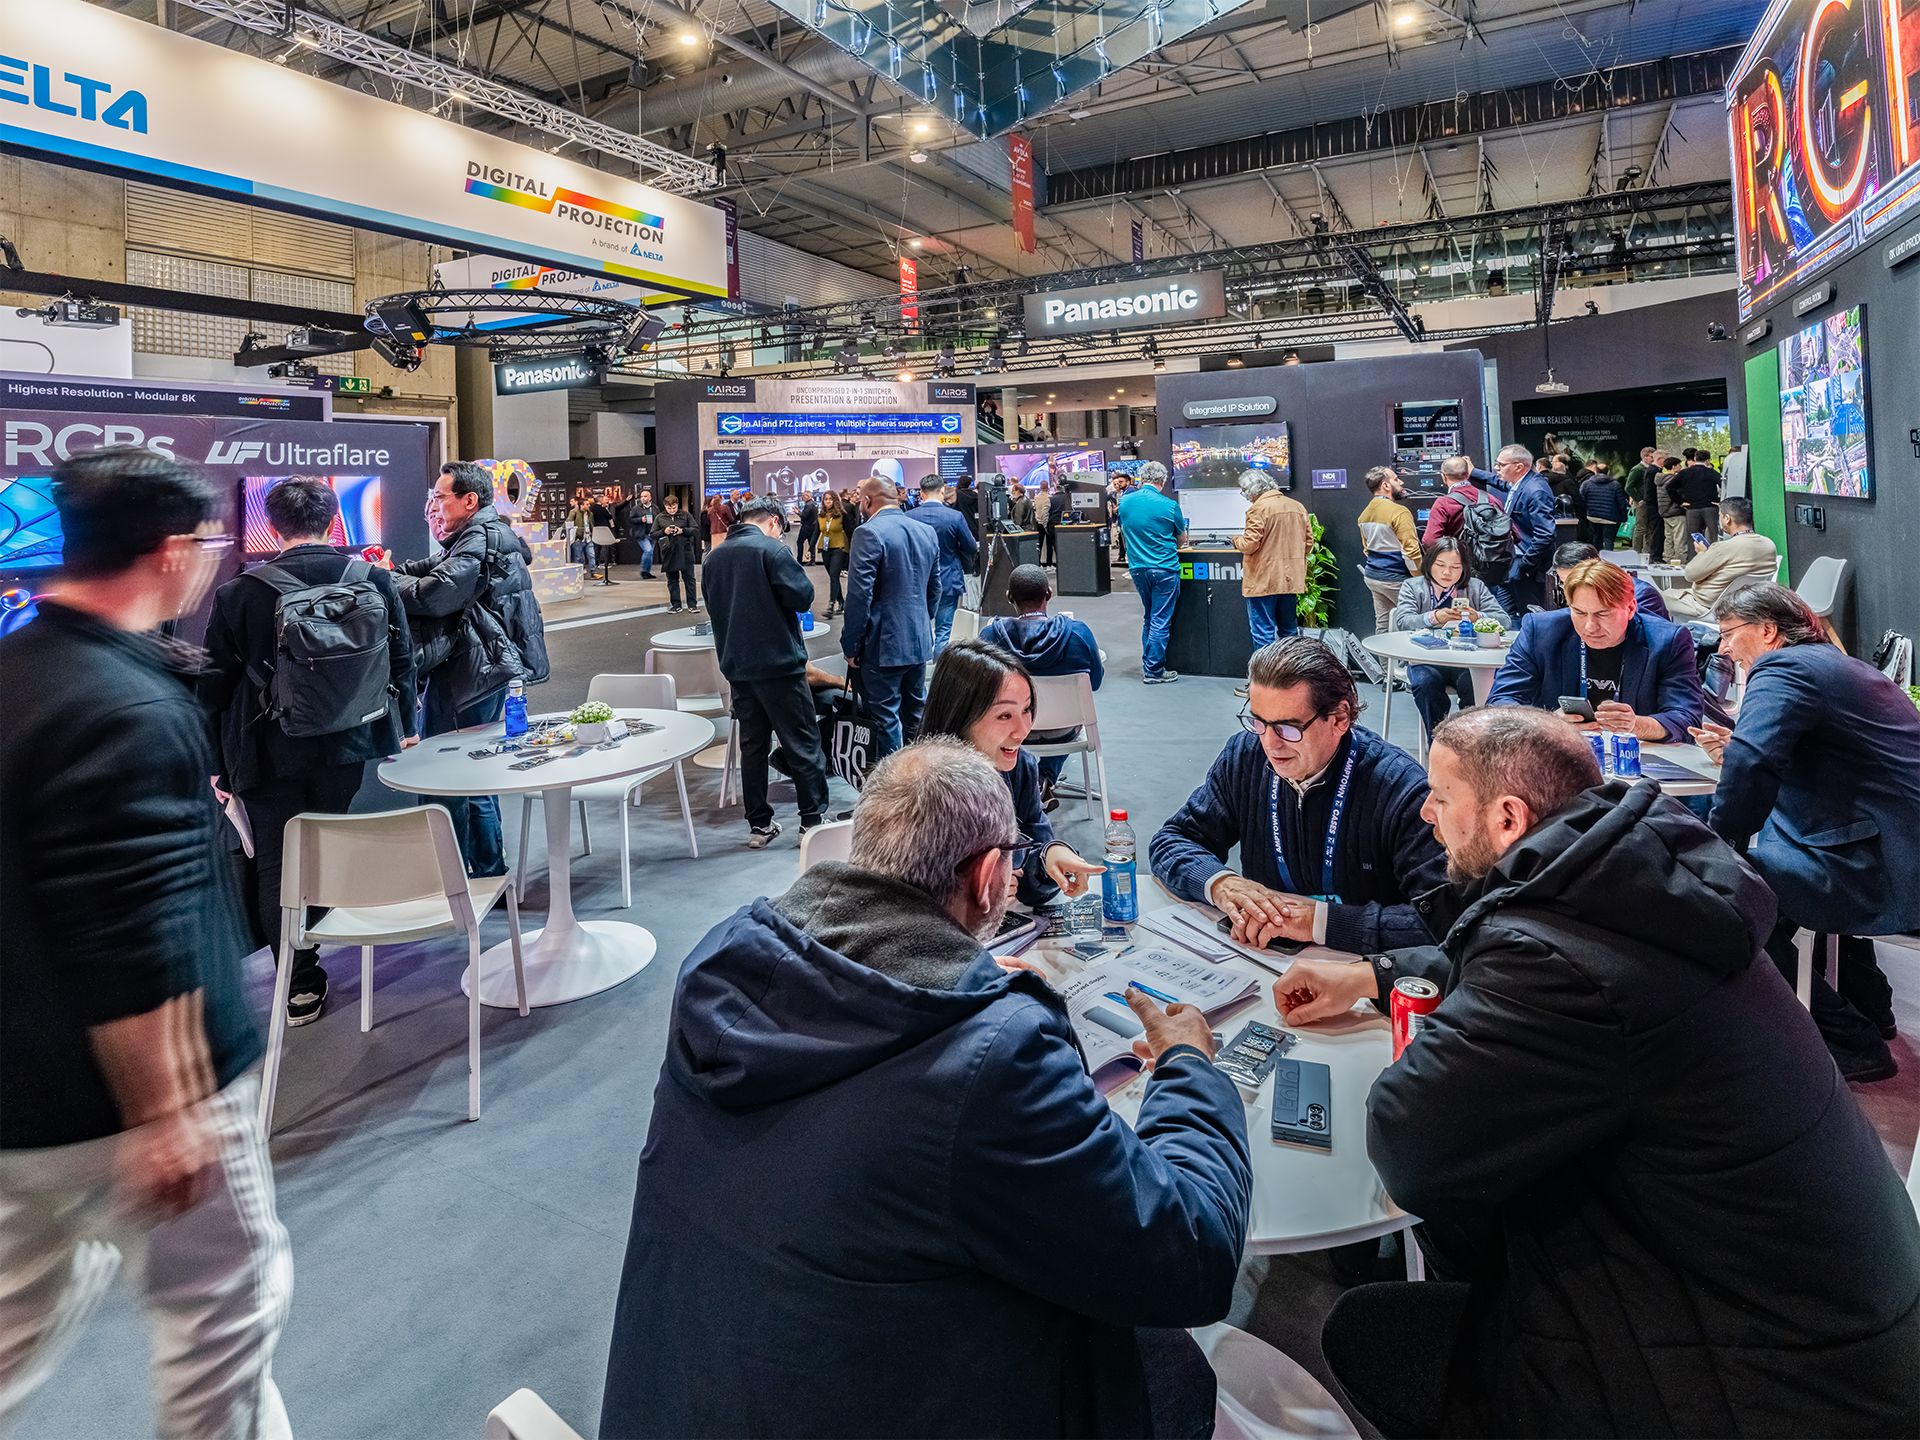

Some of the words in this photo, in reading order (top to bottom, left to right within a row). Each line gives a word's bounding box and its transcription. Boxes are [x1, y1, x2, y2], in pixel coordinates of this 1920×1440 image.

[1738, 0, 1920, 284] RG
[467, 160, 548, 197] DIGITAL
[557, 203, 664, 245] PROJECTION
[592, 238, 598, 246] A
[599, 239, 621, 252] brand
[621, 245, 628, 253] of
[643, 252, 664, 262] DELTA
[491, 264, 536, 283] DIGITAL
[1044, 284, 1199, 325] Panasonic
[504, 361, 586, 387] Panasonic
[8, 384, 59, 397] Highest
[61, 387, 124, 400] Resolution
[134, 391, 180, 402] Modular
[181, 394, 197, 403] 8K
[707, 385, 747, 393] KAIROS
[790, 394, 846, 405] PRESENTATION
[847, 394, 852, 404] &
[853, 394, 898, 405] PRODUCTION
[796, 386, 846, 395] UNCOMPROMISED
[864, 386, 892, 395] SWITCHER
[935, 388, 968, 397] KAIROS
[1189, 405, 1227, 416] Integrated
[1228, 403, 1236, 413] IP
[1237, 402, 1270, 412] Solution
[1520, 416, 1547, 425] RETHINK
[1547, 415, 1573, 425] REALISM
[835, 420, 866, 429] Multiple
[897, 420, 933, 429] supported
[265, 442, 390, 466] Ultraflare
[1336, 757, 1354, 798] AMPTOWN
[1271, 811, 1283, 854] AMPTOWN
[1328, 809, 1340, 835] CASES
